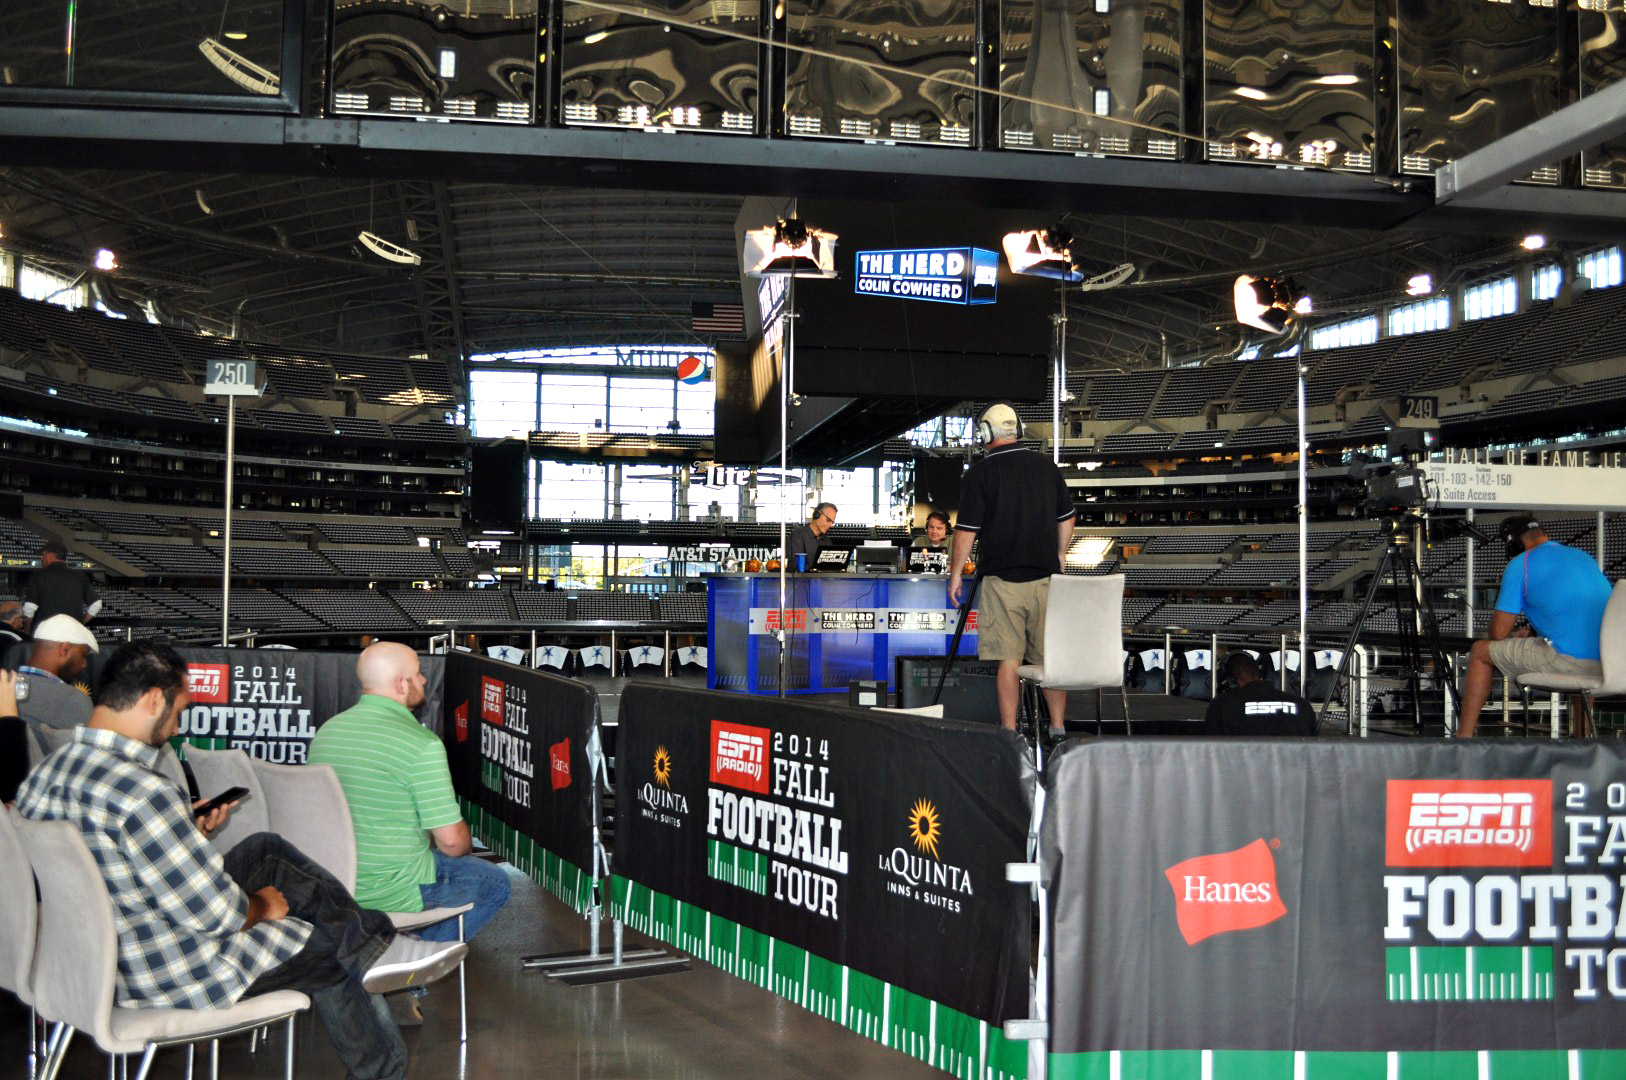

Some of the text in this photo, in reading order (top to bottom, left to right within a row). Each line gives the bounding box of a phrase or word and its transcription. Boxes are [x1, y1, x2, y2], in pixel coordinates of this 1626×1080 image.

[860, 254, 894, 273] THE
[900, 253, 965, 276] HERD
[858, 279, 963, 299] COLIN COWHERD
[214, 362, 247, 385] 250
[1406, 399, 1432, 419] 249
[1446, 447, 1492, 465] HALL
[1506, 449, 1527, 466] OF
[1541, 450, 1590, 467] FAME
[706, 466, 750, 487] Lite
[1475, 473, 1512, 486] 142-150
[1444, 488, 1465, 500] Suite
[1467, 488, 1496, 501] Access
[668, 547, 777, 562] AT&T STADIUM
[820, 551, 849, 560] ESPN
[824, 612, 874, 621] THE HERD
[889, 613, 910, 621] THE
[235, 666, 296, 679] 2014
[233, 680, 302, 704] FALL
[505, 702, 529, 734] FALL
[1244, 701, 1297, 715] ESPN
[178, 705, 316, 738] OOTBALL
[231, 740, 307, 764] TOUR
[481, 722, 534, 778] FOOTBALL
[717, 730, 764, 763] ESPN
[774, 732, 829, 761] 2014
[722, 755, 756, 775] RADIO
[773, 757, 835, 808] FALL
[660, 813, 681, 828] SUITES
[1408, 792, 1532, 827] ESPN
[707, 787, 848, 875] FOOTBALL
[1422, 828, 1516, 845] RADIO
[772, 860, 838, 920] TOUR
[887, 881, 961, 913] INNS & SUITES
[1183, 875, 1271, 903] Hanes
[1383, 875, 1626, 940] FOOTB
